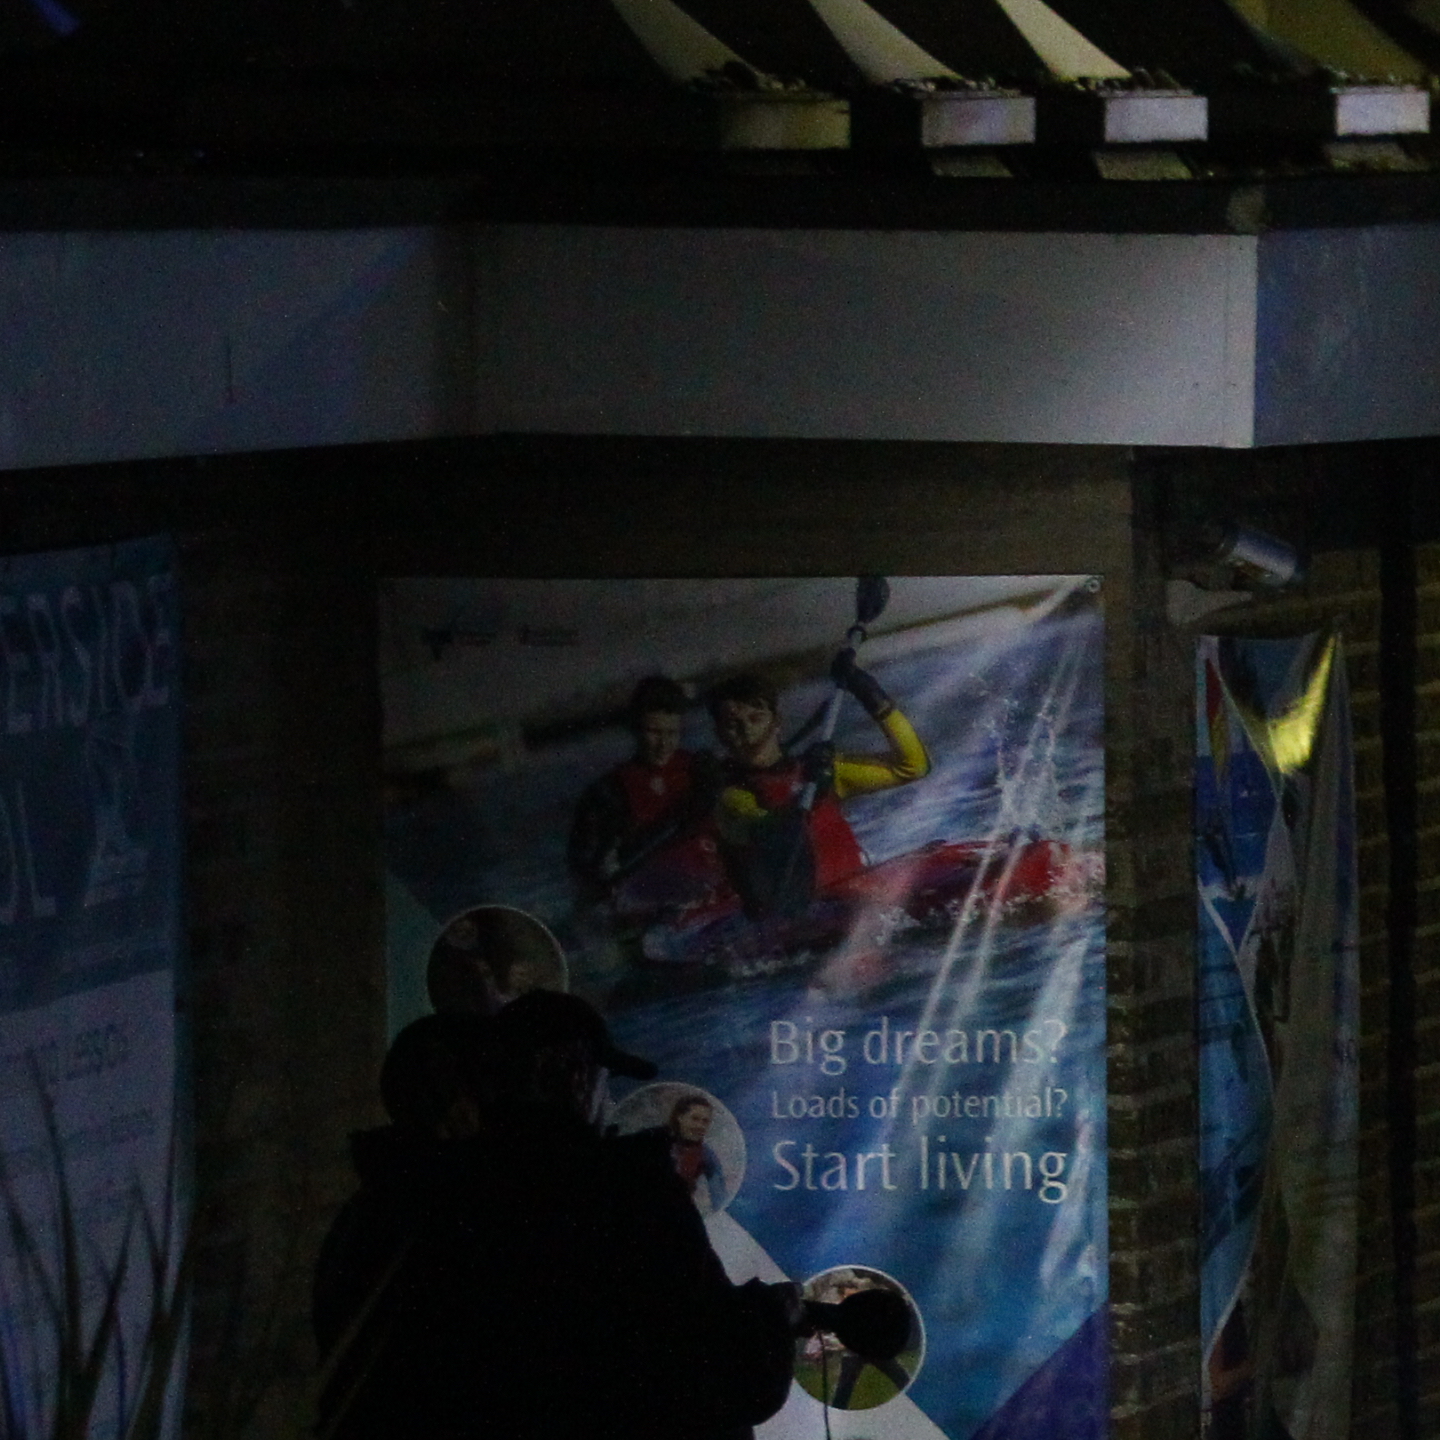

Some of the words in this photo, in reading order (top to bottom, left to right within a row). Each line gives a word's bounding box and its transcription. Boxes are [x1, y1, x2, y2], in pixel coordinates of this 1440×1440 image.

[770, 1016, 847, 1076] Big
[863, 1015, 1068, 1065] dreams?
[772, 1086, 860, 1119] Loads
[869, 1087, 900, 1119] of
[912, 1086, 1068, 1126] potential?
[772, 1139, 898, 1191] Start
[921, 1134, 1068, 1204] living
